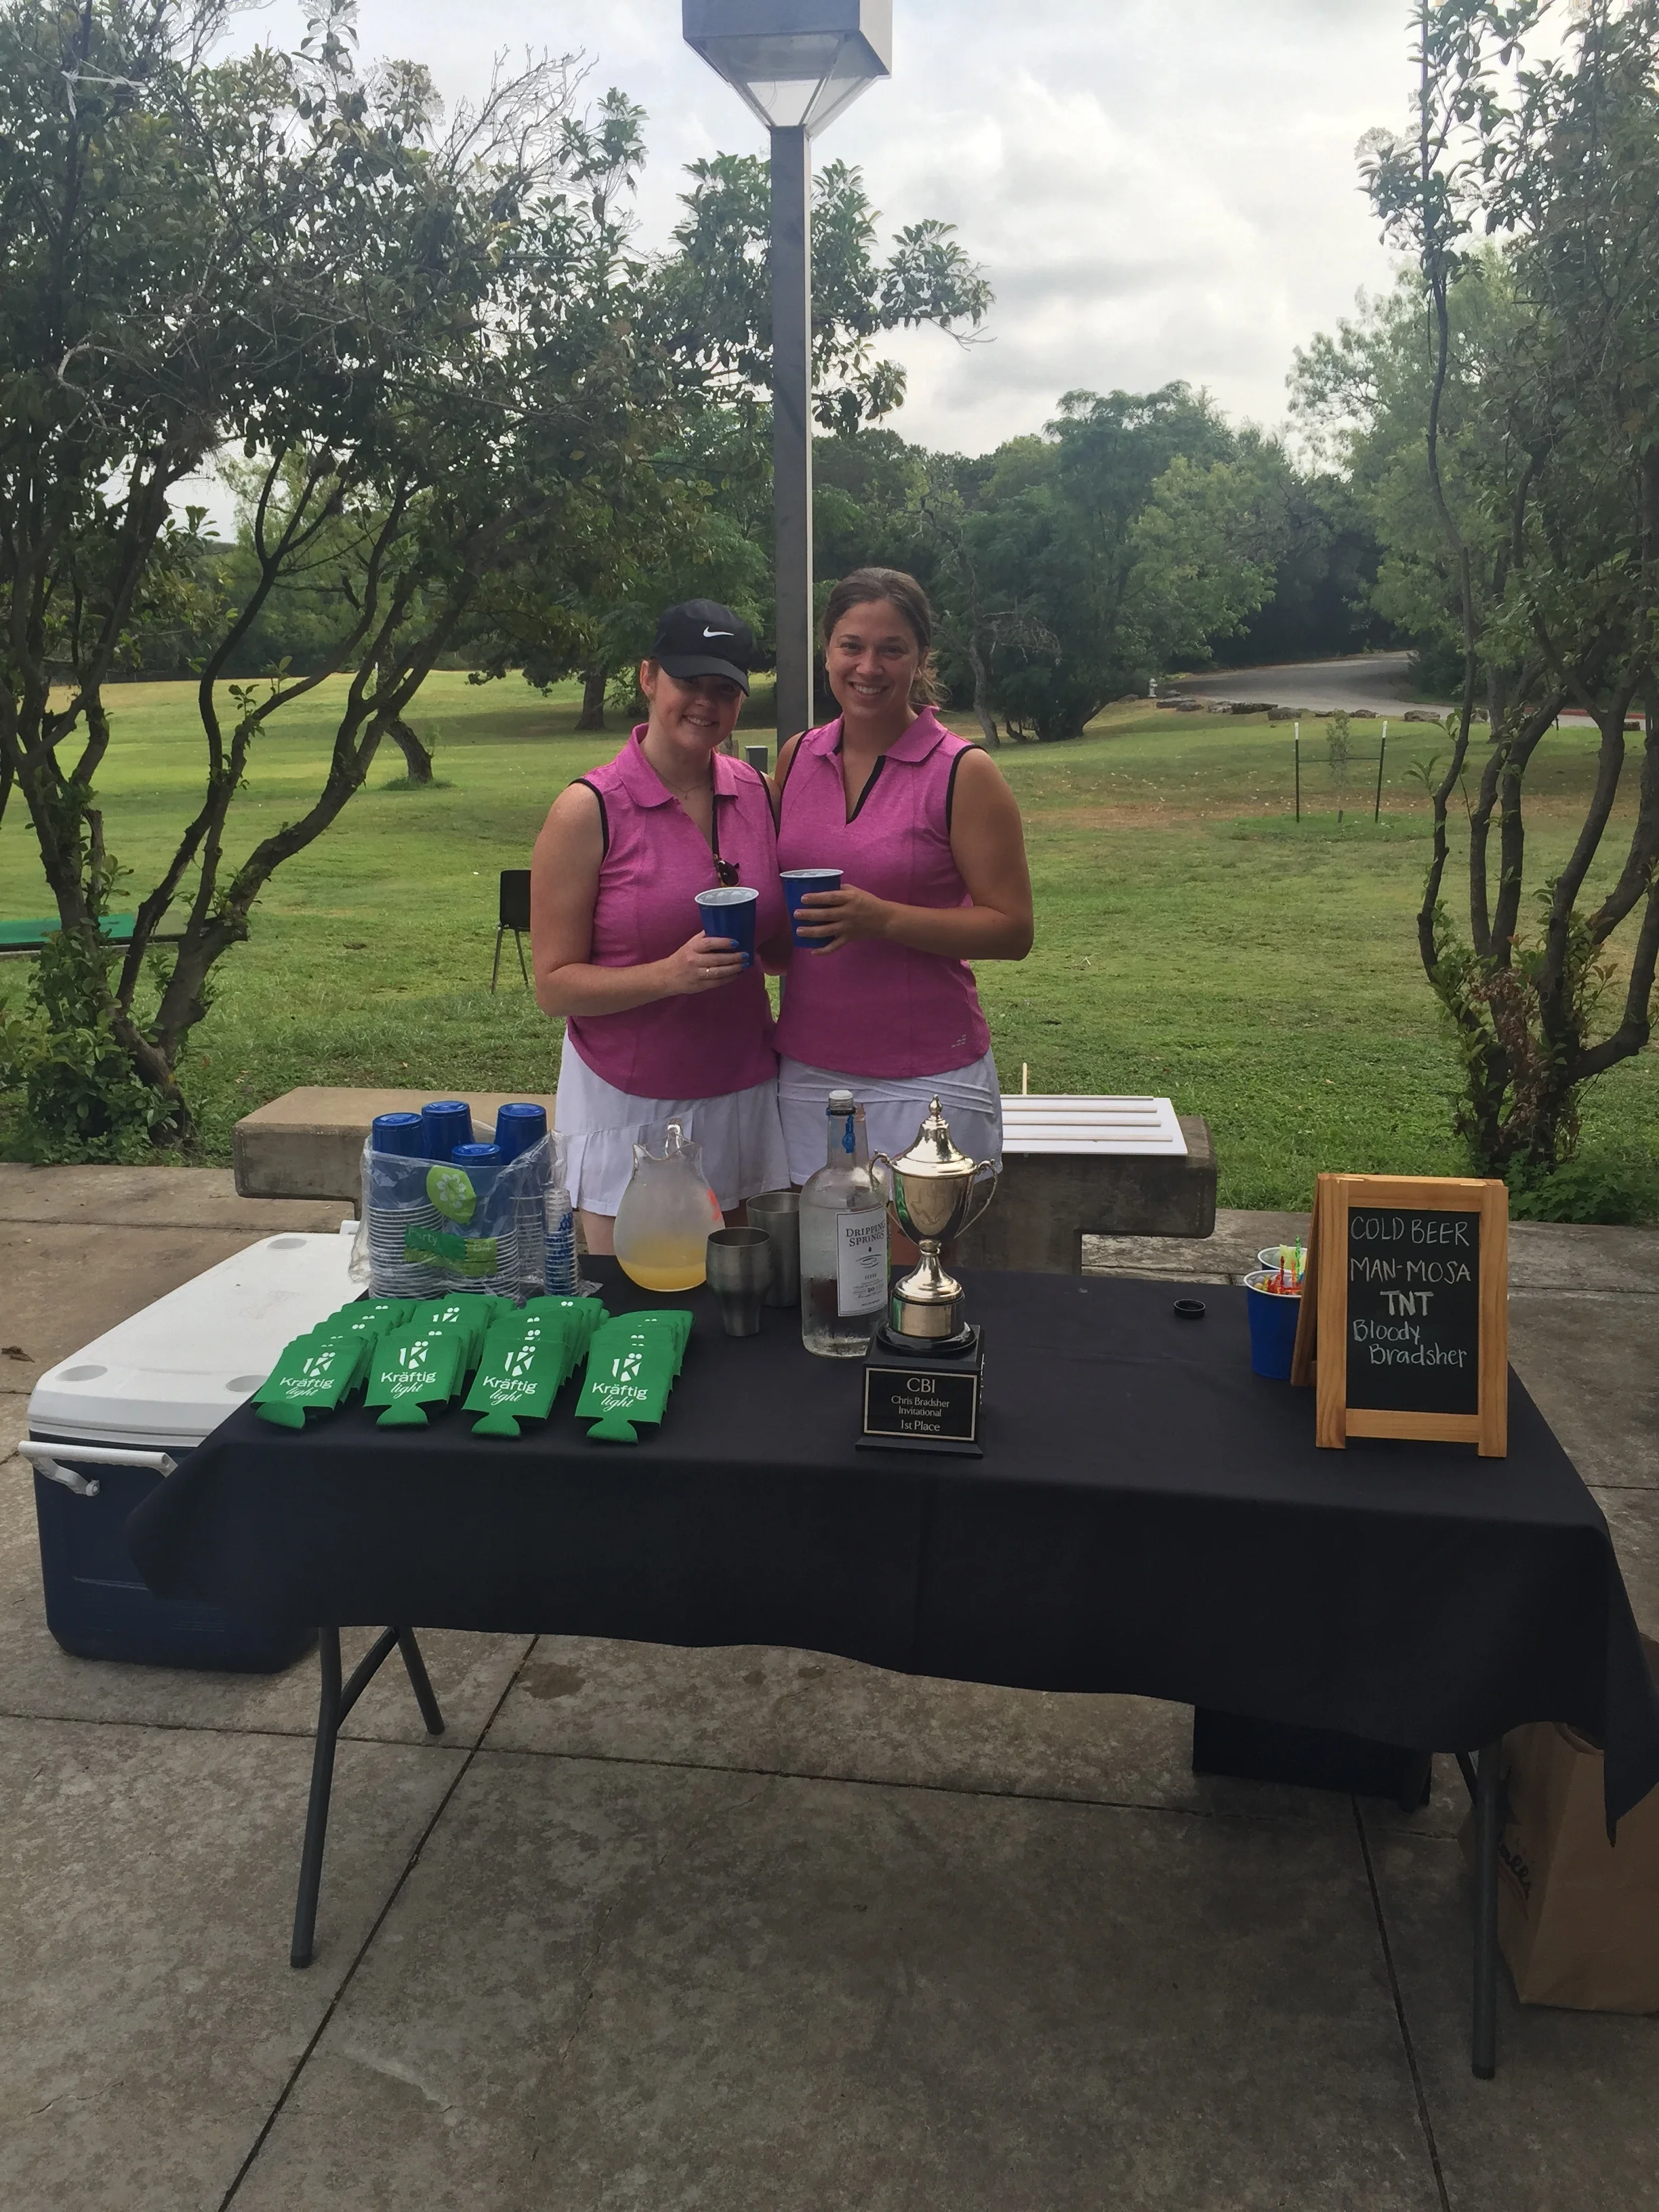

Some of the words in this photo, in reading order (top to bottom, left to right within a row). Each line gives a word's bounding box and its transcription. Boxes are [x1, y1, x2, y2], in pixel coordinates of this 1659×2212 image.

[846, 1219, 885, 1237] DRIPPING
[1350, 1216, 1405, 1241] COLD
[1411, 1219, 1470, 1246] BEER
[849, 1231, 884, 1247] SPRINGS
[1350, 1257, 1471, 1284] MAN-MOSA
[1380, 1290, 1435, 1317] TNT
[1353, 1319, 1420, 1345] Bloody
[1369, 1343, 1467, 1368] Bradsher
[279, 1377, 335, 1389] Kräftig
[380, 1371, 437, 1383] Kräftig
[483, 1375, 538, 1395] Kräftig
[906, 1377, 936, 1393] CBI
[285, 1387, 319, 1399] light
[390, 1382, 424, 1399] light
[489, 1388, 523, 1406] light
[592, 1382, 649, 1401] Kräftig
[600, 1394, 634, 1413] light
[890, 1395, 914, 1406] Chris
[914, 1397, 950, 1408] Bradsher
[899, 1406, 942, 1417] Invitational
[901, 1419, 912, 1430] 1st
[914, 1420, 941, 1432] Place
